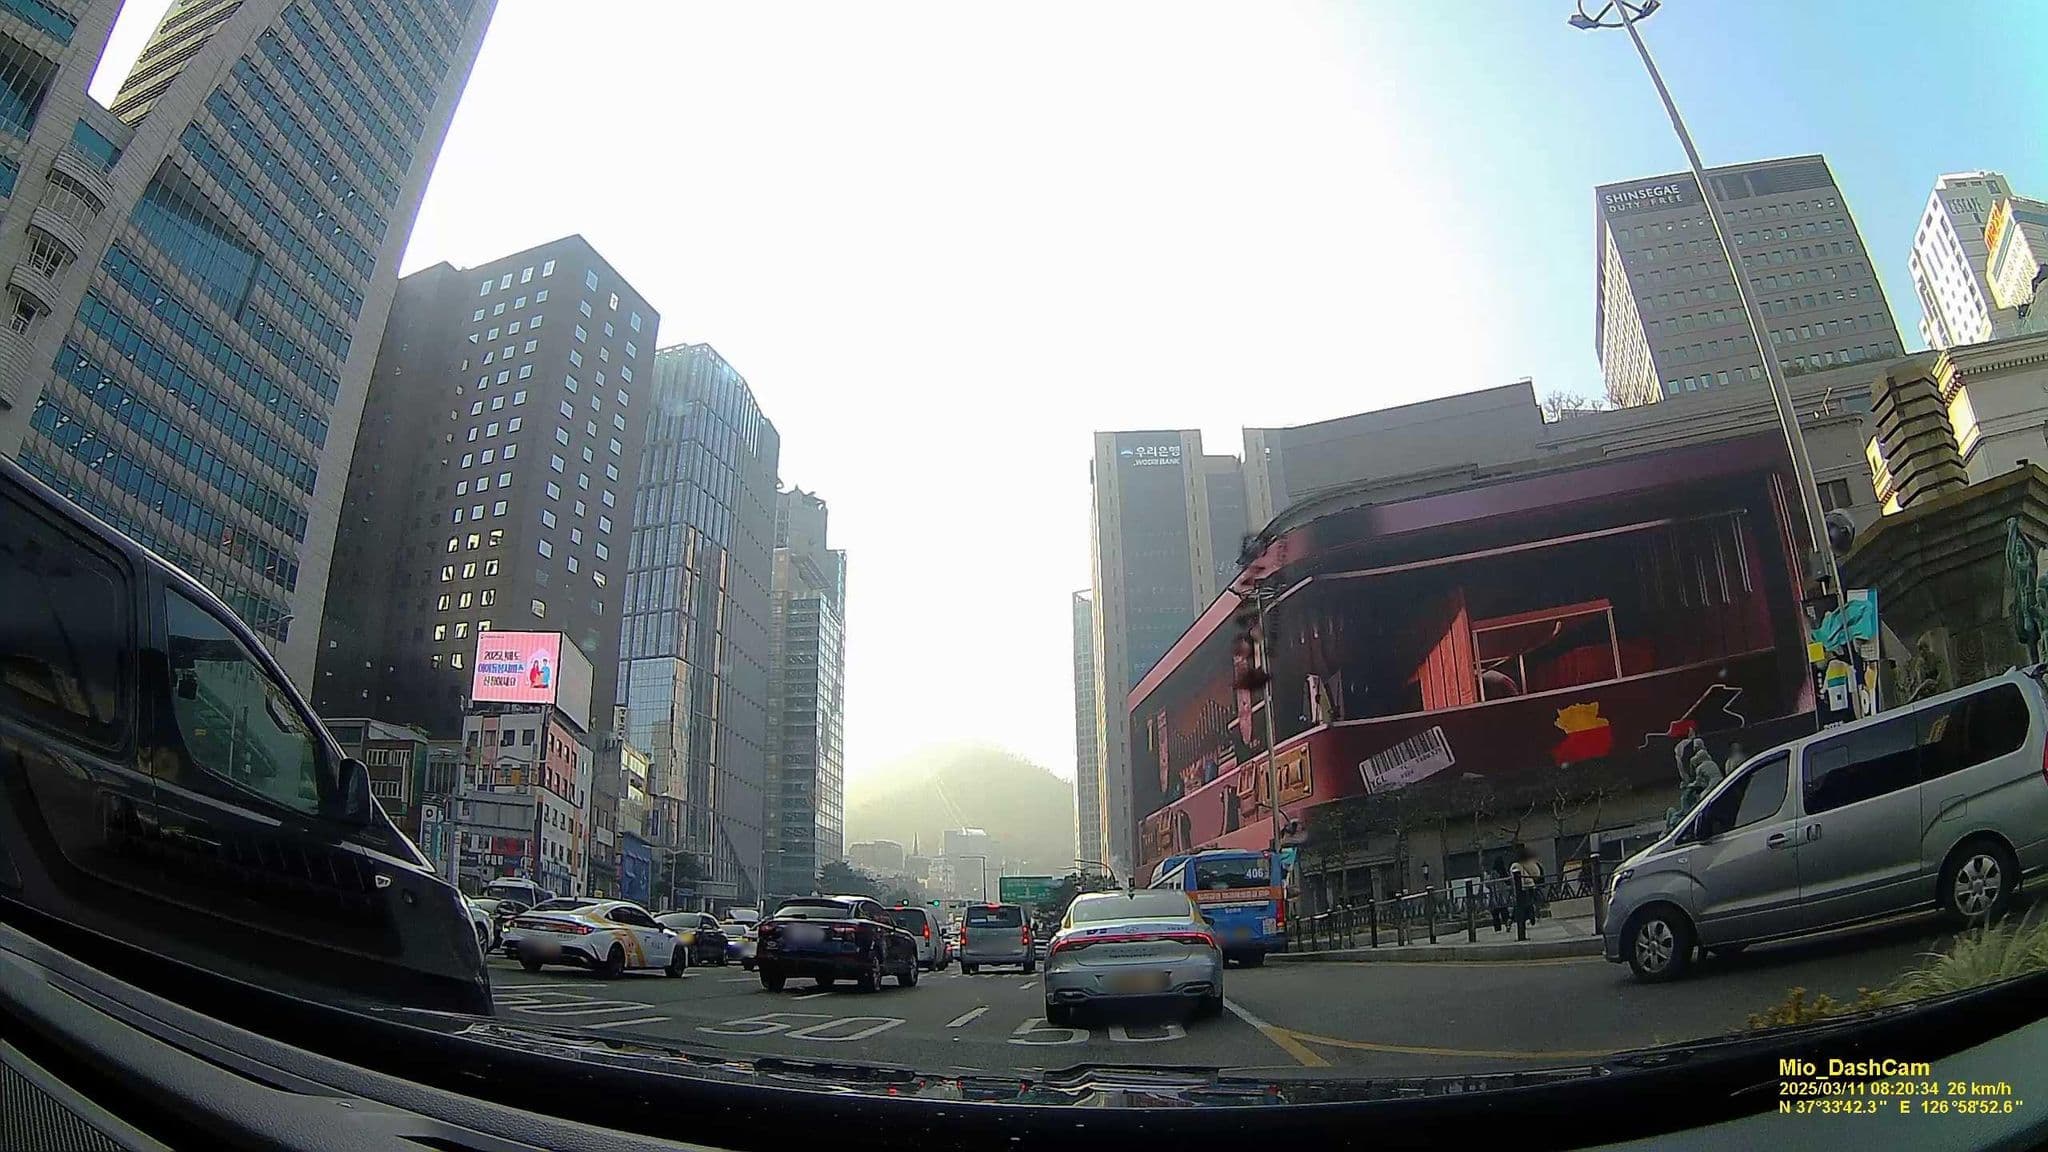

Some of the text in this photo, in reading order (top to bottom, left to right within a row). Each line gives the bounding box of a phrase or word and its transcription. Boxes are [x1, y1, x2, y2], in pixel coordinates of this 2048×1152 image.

[1605, 184, 1680, 205] SHINSEGAE
[1609, 194, 1683, 213] DUTY FREE
[1135, 445, 1181, 458] 우리은행
[1246, 867, 1264, 879] 406
[696, 1013, 907, 1041] 50
